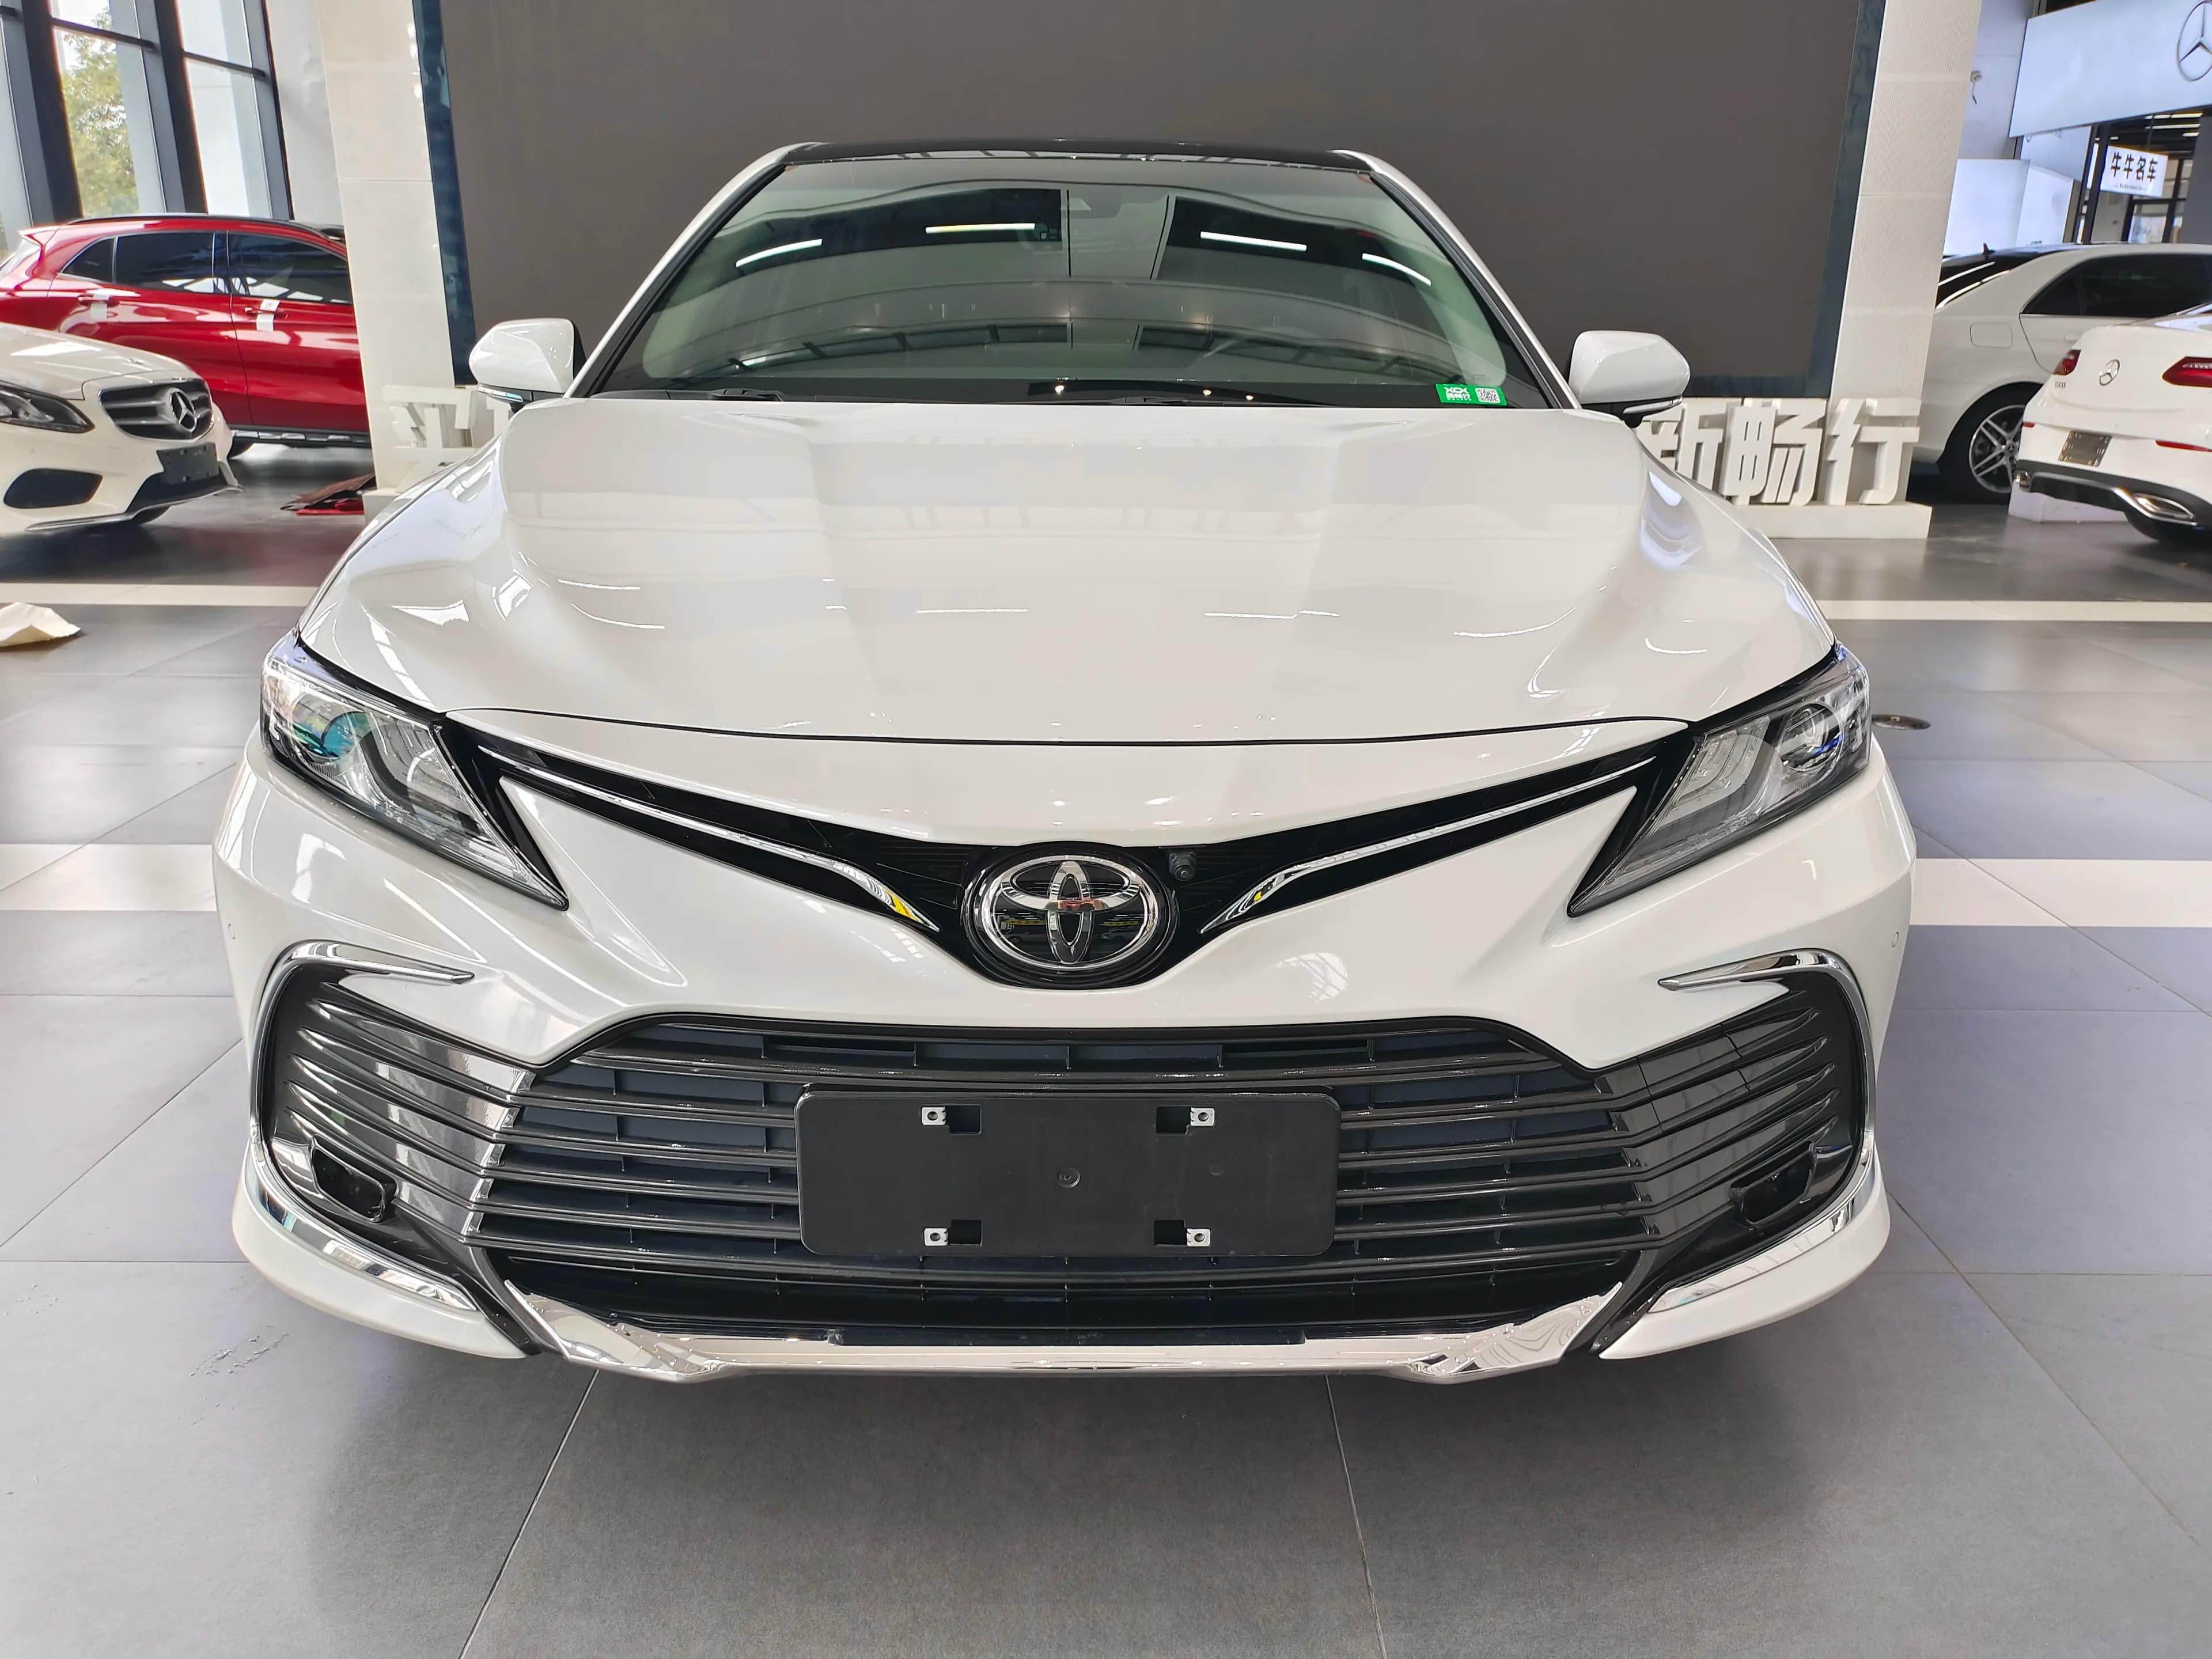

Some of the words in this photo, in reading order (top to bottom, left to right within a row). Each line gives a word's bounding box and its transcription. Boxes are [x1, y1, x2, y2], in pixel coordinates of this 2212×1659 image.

[2111, 151, 2158, 183] 牛牛名车
[1636, 397, 1922, 505] 新畅行
